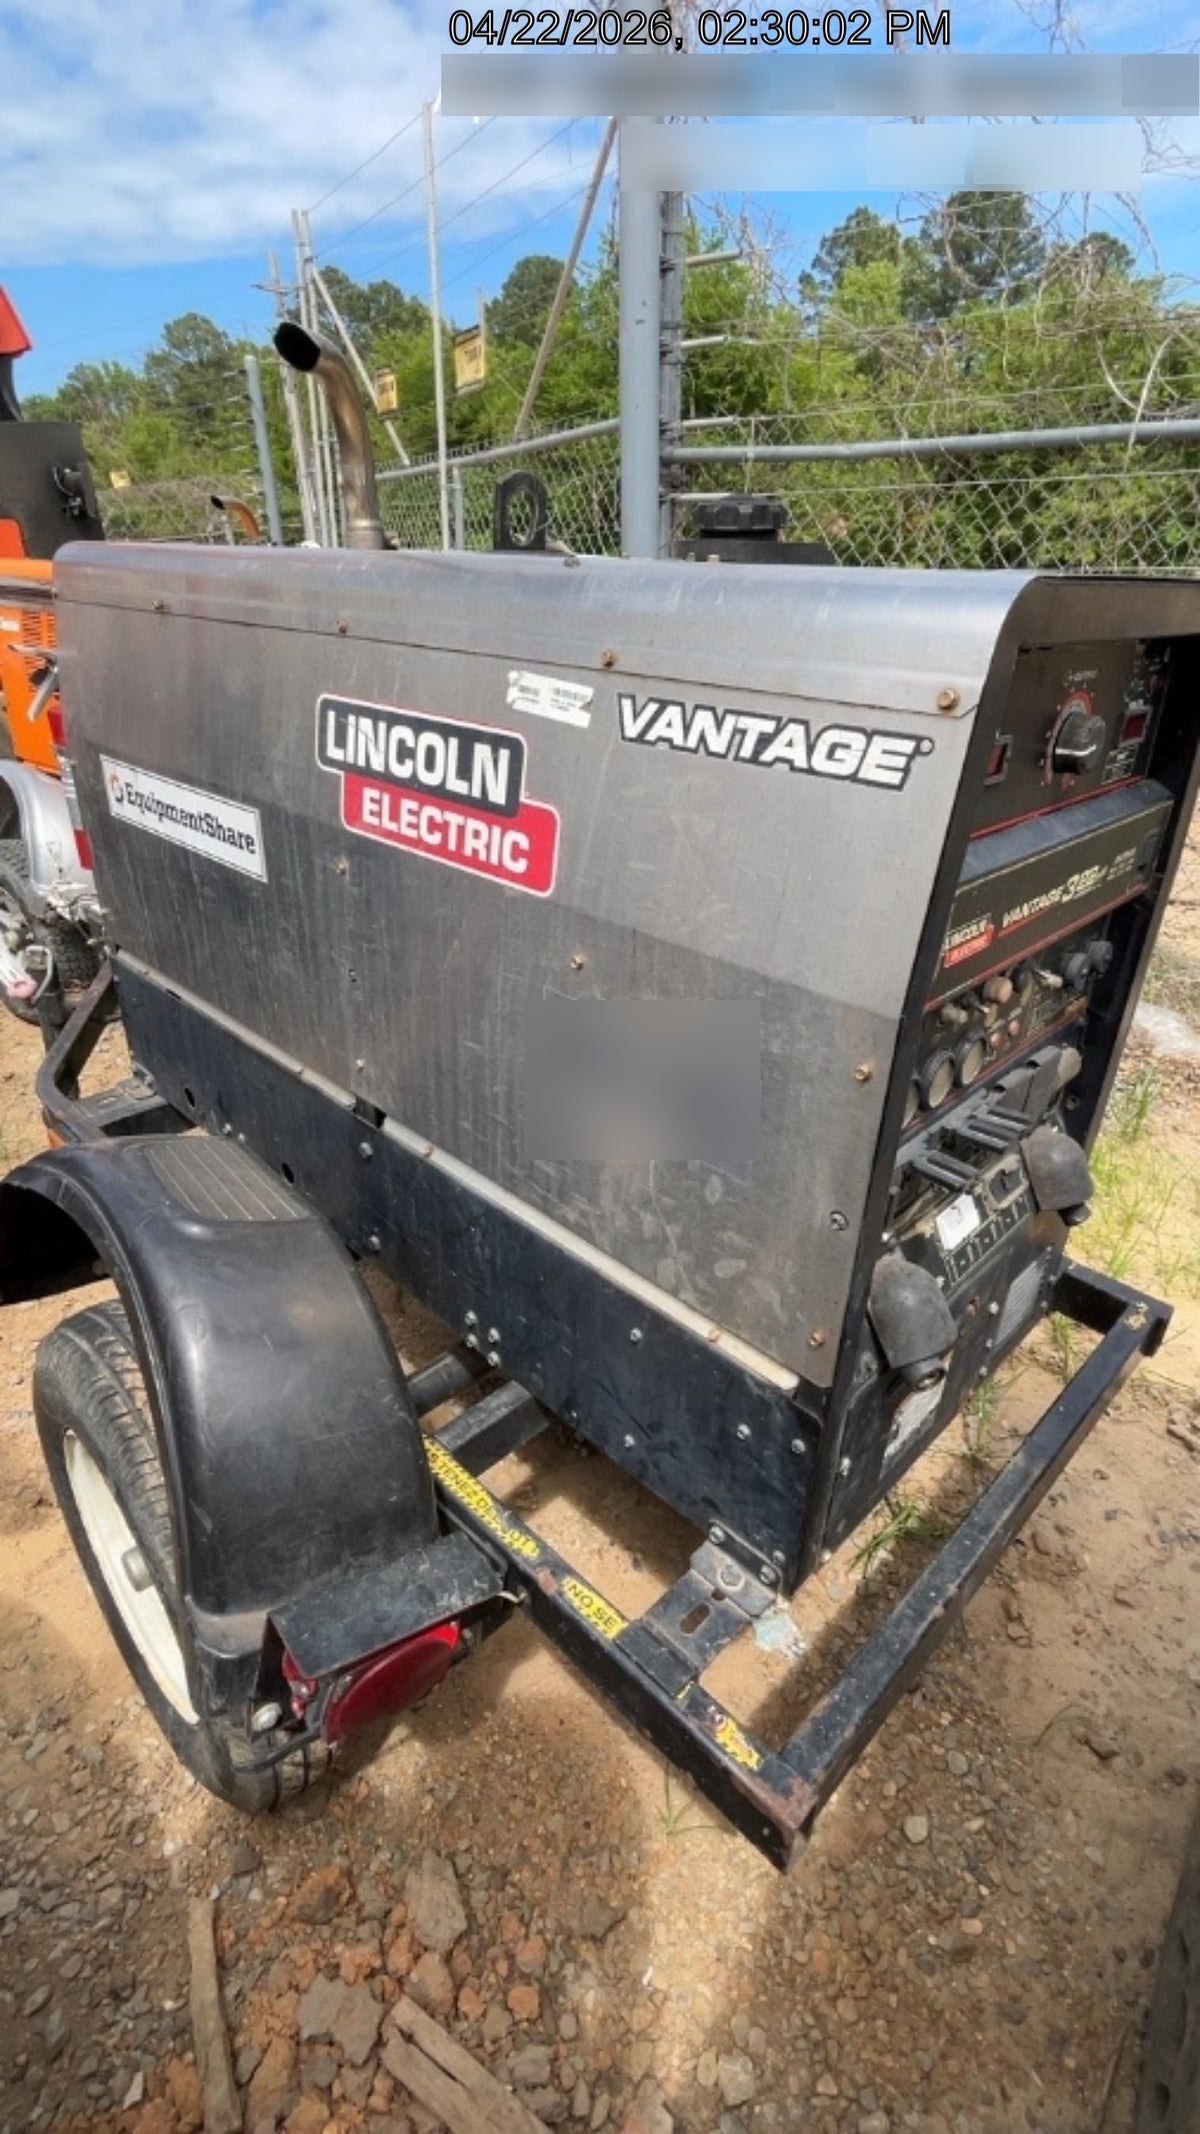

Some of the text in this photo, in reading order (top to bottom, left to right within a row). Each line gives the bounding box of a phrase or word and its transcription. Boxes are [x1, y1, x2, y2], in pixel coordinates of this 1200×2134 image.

[326, 710, 511, 806] LINCOLN
[617, 692, 922, 792] VANTAGE
[125, 782, 256, 854] EquipmentShare
[362, 787, 530, 874] ELECTRIC
[568, 1584, 593, 1608] NO
